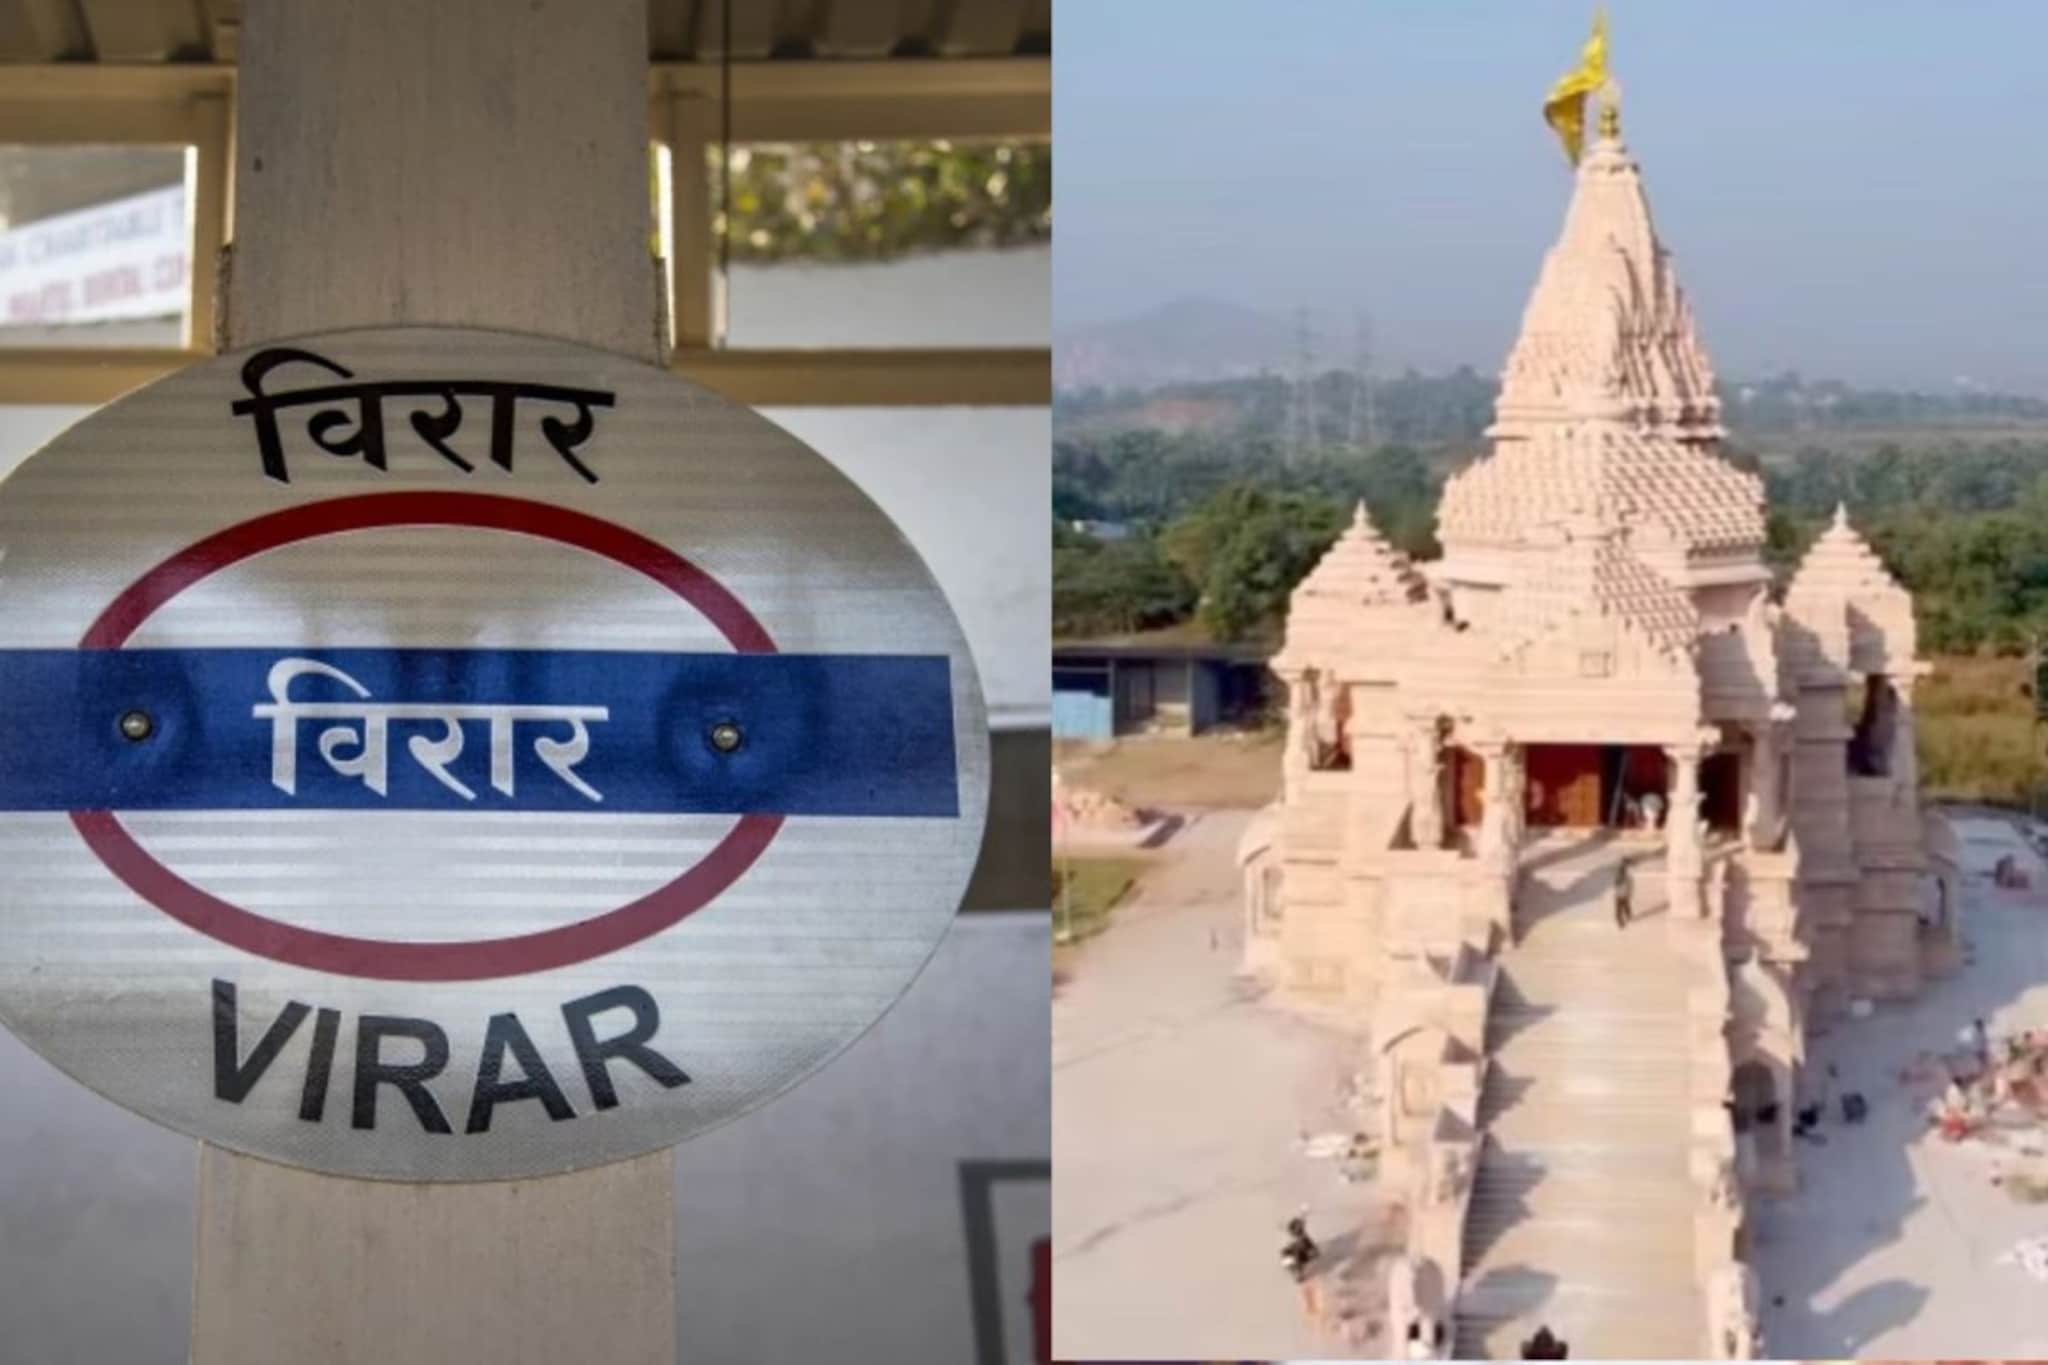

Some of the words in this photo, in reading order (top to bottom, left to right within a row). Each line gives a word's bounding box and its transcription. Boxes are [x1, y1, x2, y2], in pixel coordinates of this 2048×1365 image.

[233, 348, 614, 484] विरार
[253, 658, 608, 801] विरार
[211, 979, 690, 1135] VIRAR
